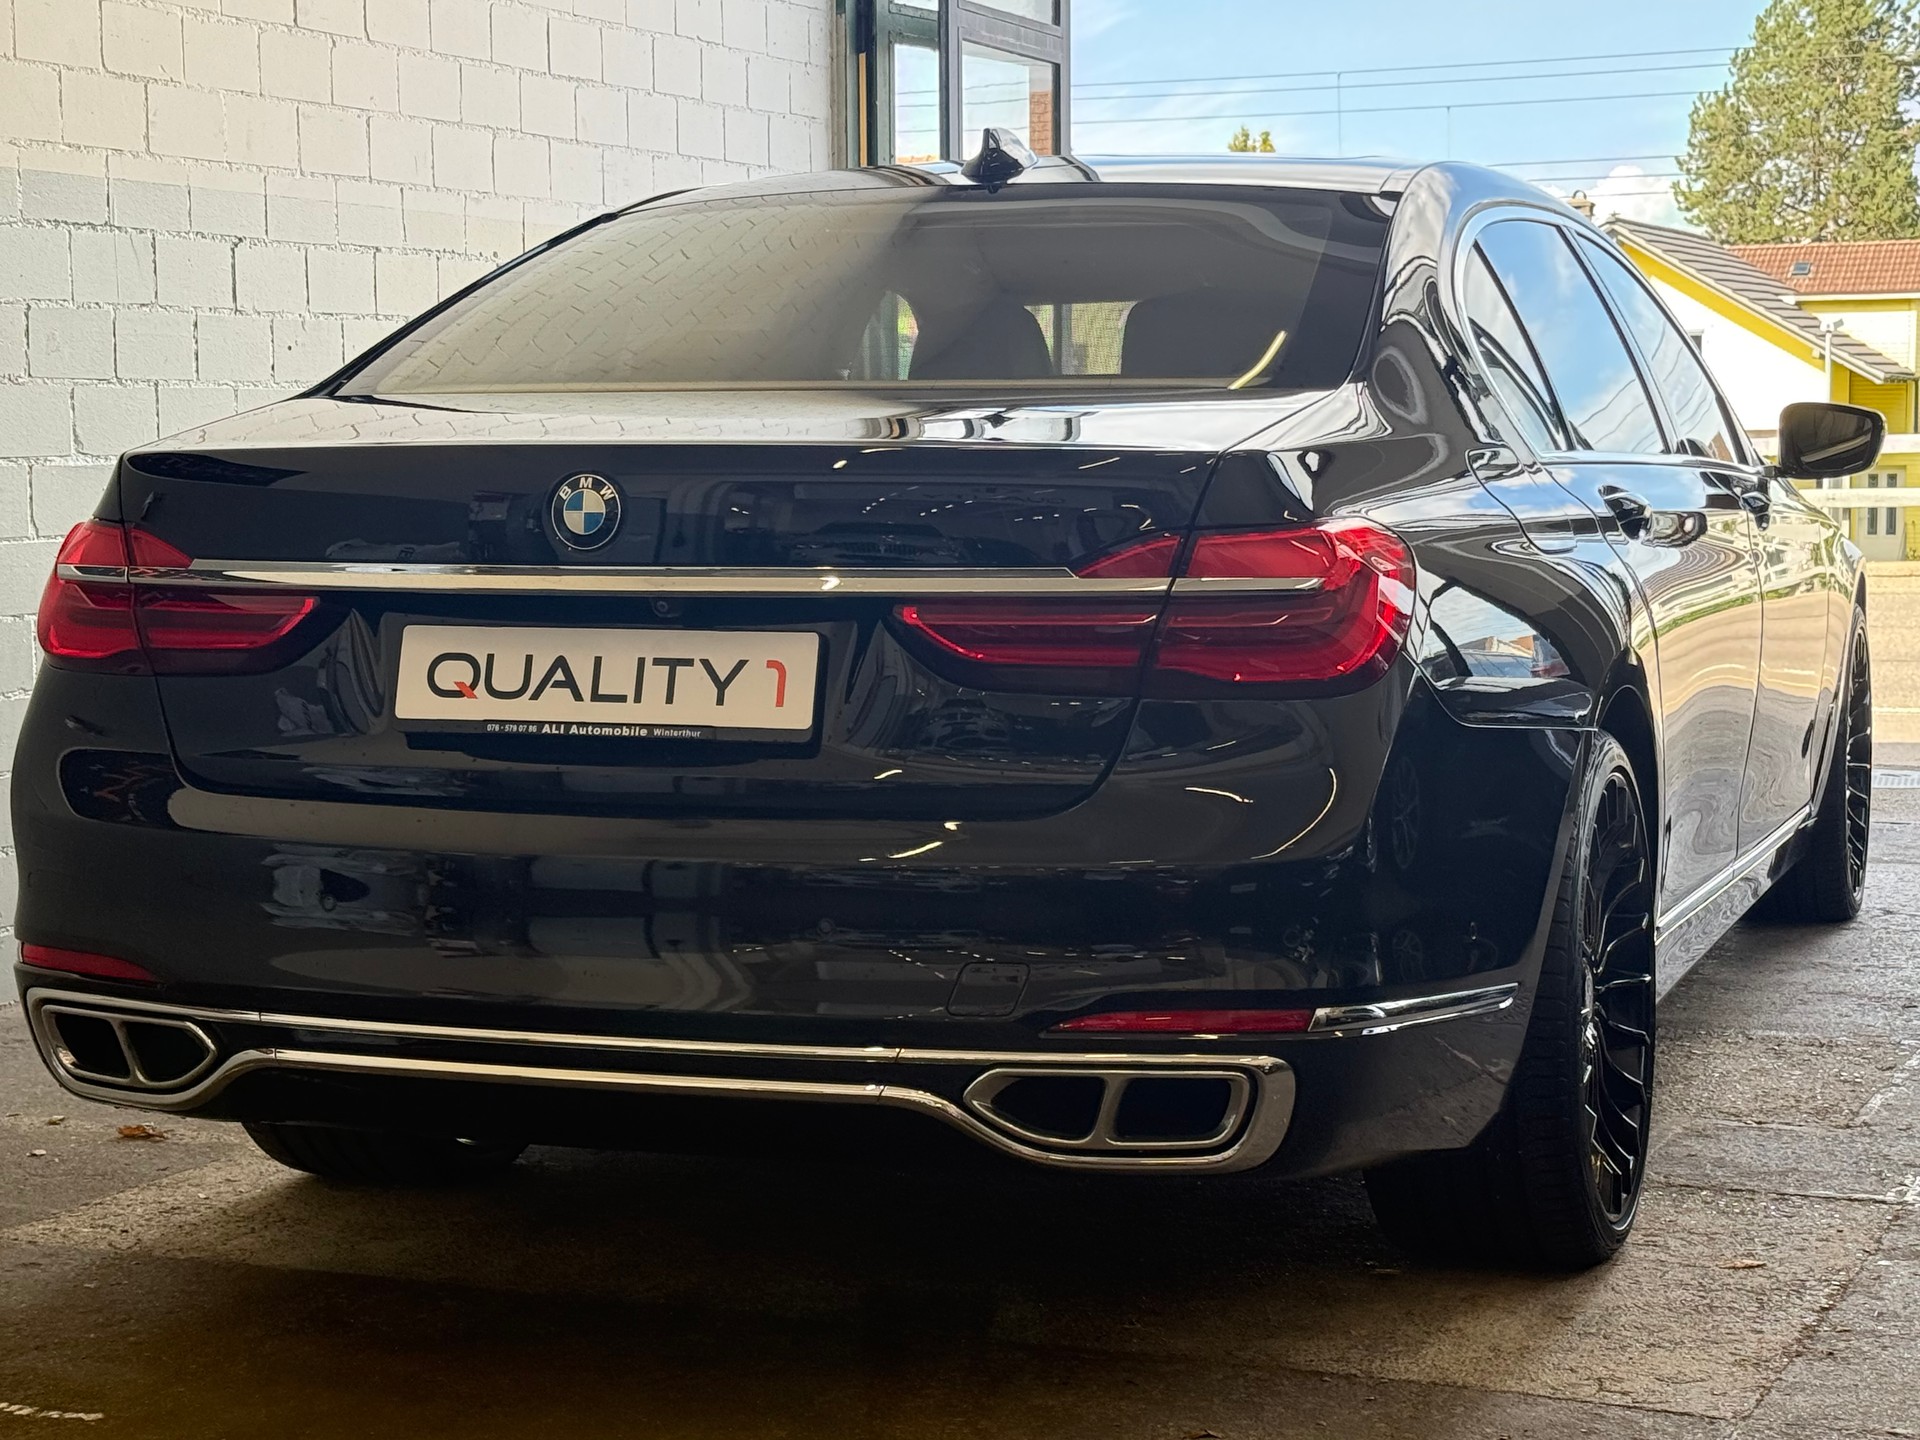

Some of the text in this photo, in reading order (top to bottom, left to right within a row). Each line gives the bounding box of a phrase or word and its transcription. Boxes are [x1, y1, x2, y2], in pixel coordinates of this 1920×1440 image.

[559, 477, 615, 501] BMW
[427, 652, 787, 707] QUALITY 1
[541, 724, 564, 734] ALI
[569, 725, 648, 737] Automobile
[653, 728, 701, 738] Winterthur
